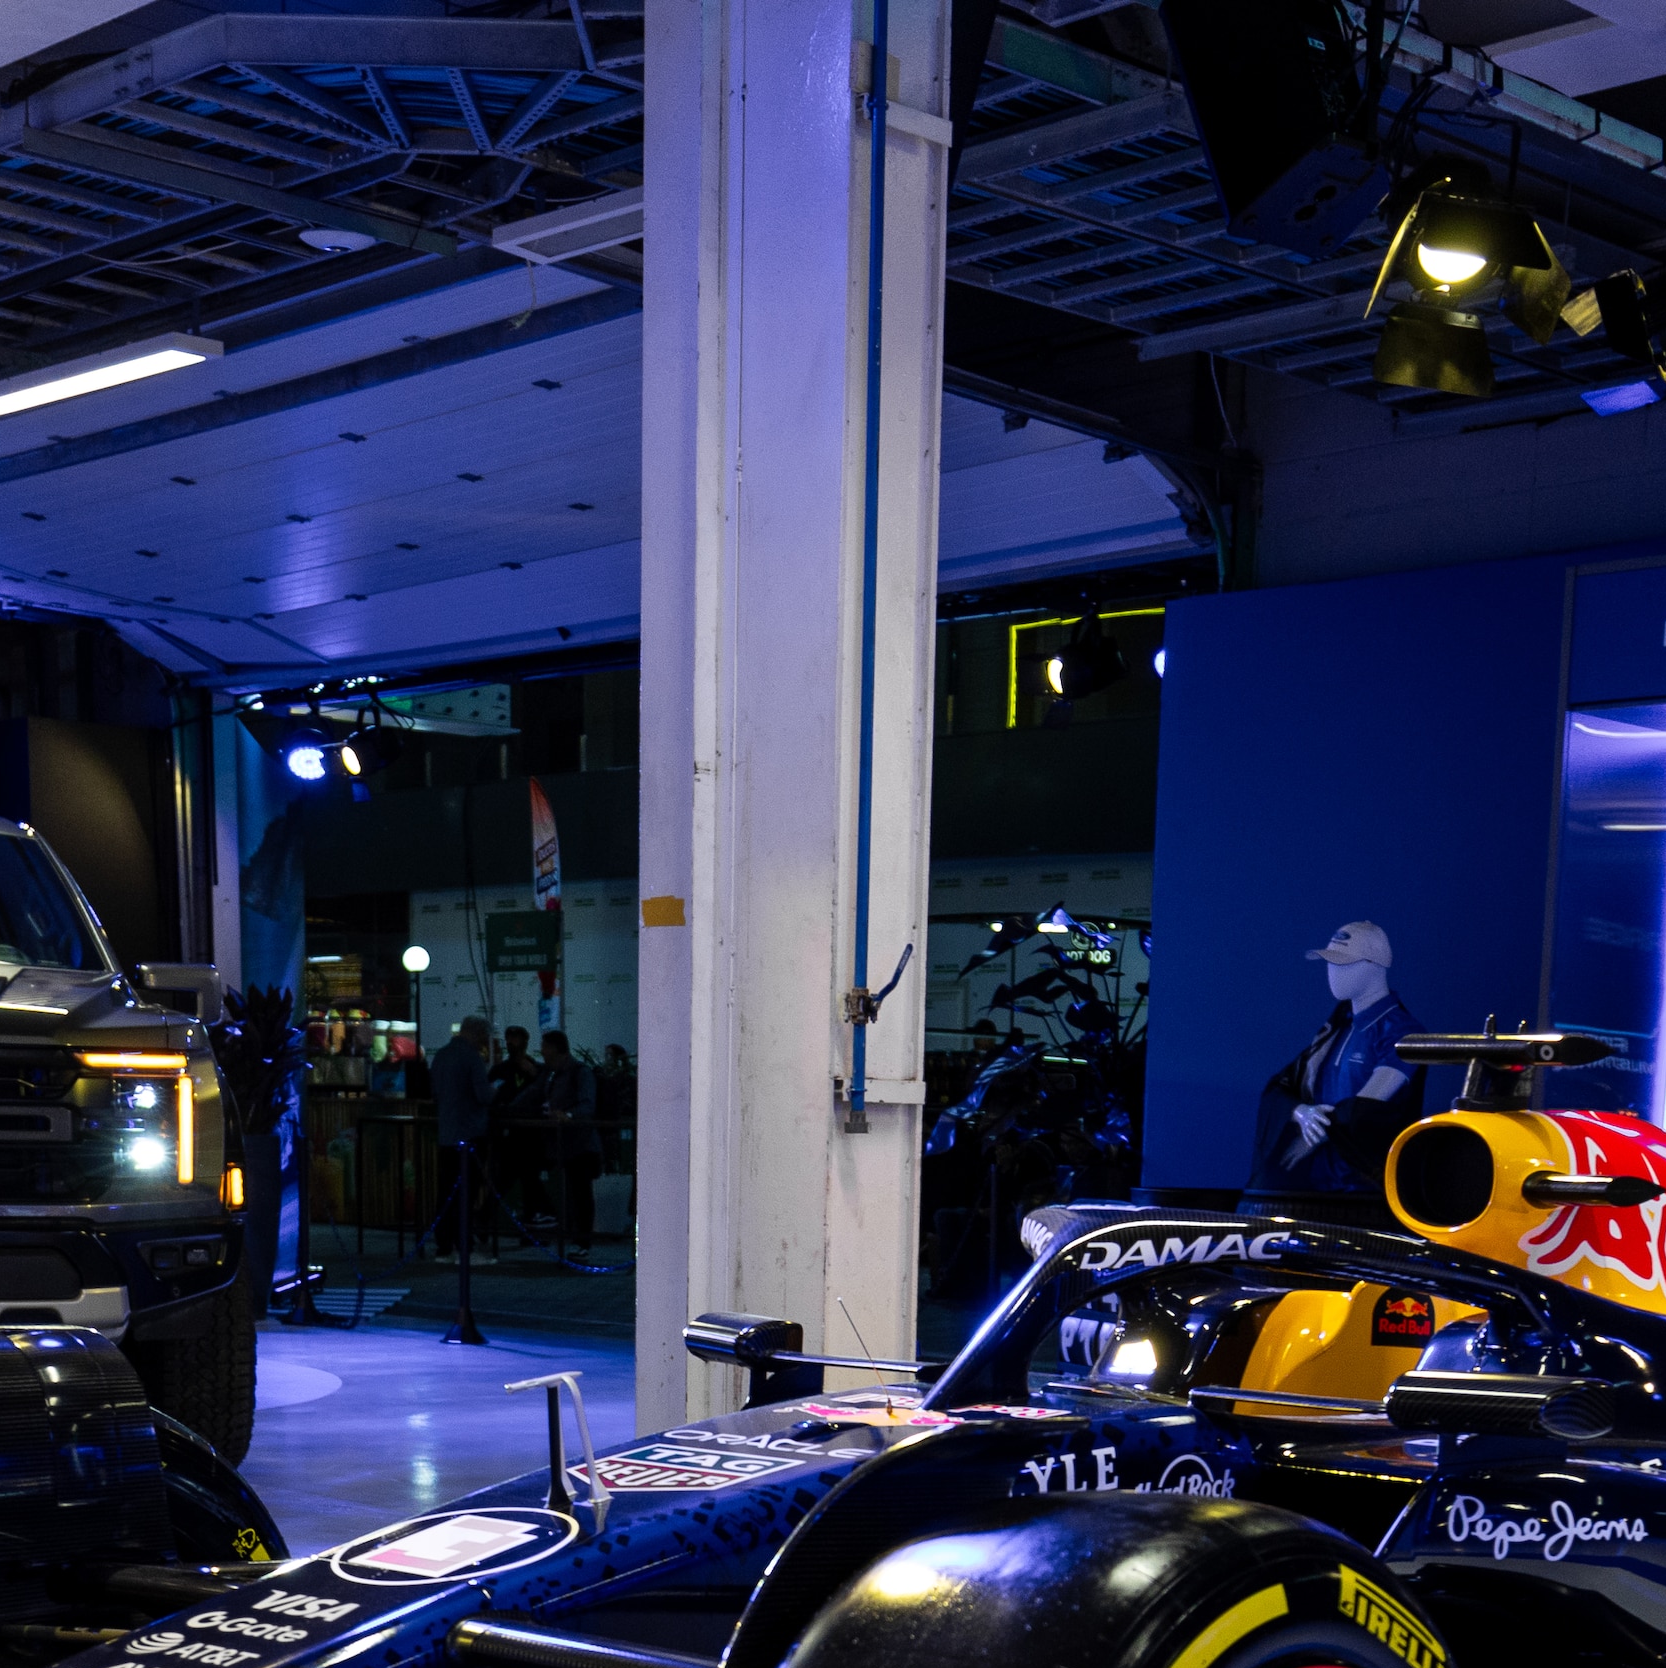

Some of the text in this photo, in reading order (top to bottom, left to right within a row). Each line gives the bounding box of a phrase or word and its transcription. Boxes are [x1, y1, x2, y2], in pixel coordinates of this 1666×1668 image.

[1079, 1231, 1292, 1270] DAMAC
[1378, 1317, 1432, 1337] Red Bull
[661, 1428, 879, 1459] ORACLE
[592, 1461, 732, 1487] HEUER
[644, 1446, 775, 1474] TAG
[1447, 1493, 1650, 1562] Pepe Jeans
[252, 1590, 361, 1622] VISA
[221, 1614, 310, 1643] Gate
[179, 1641, 261, 1667] AT&T
